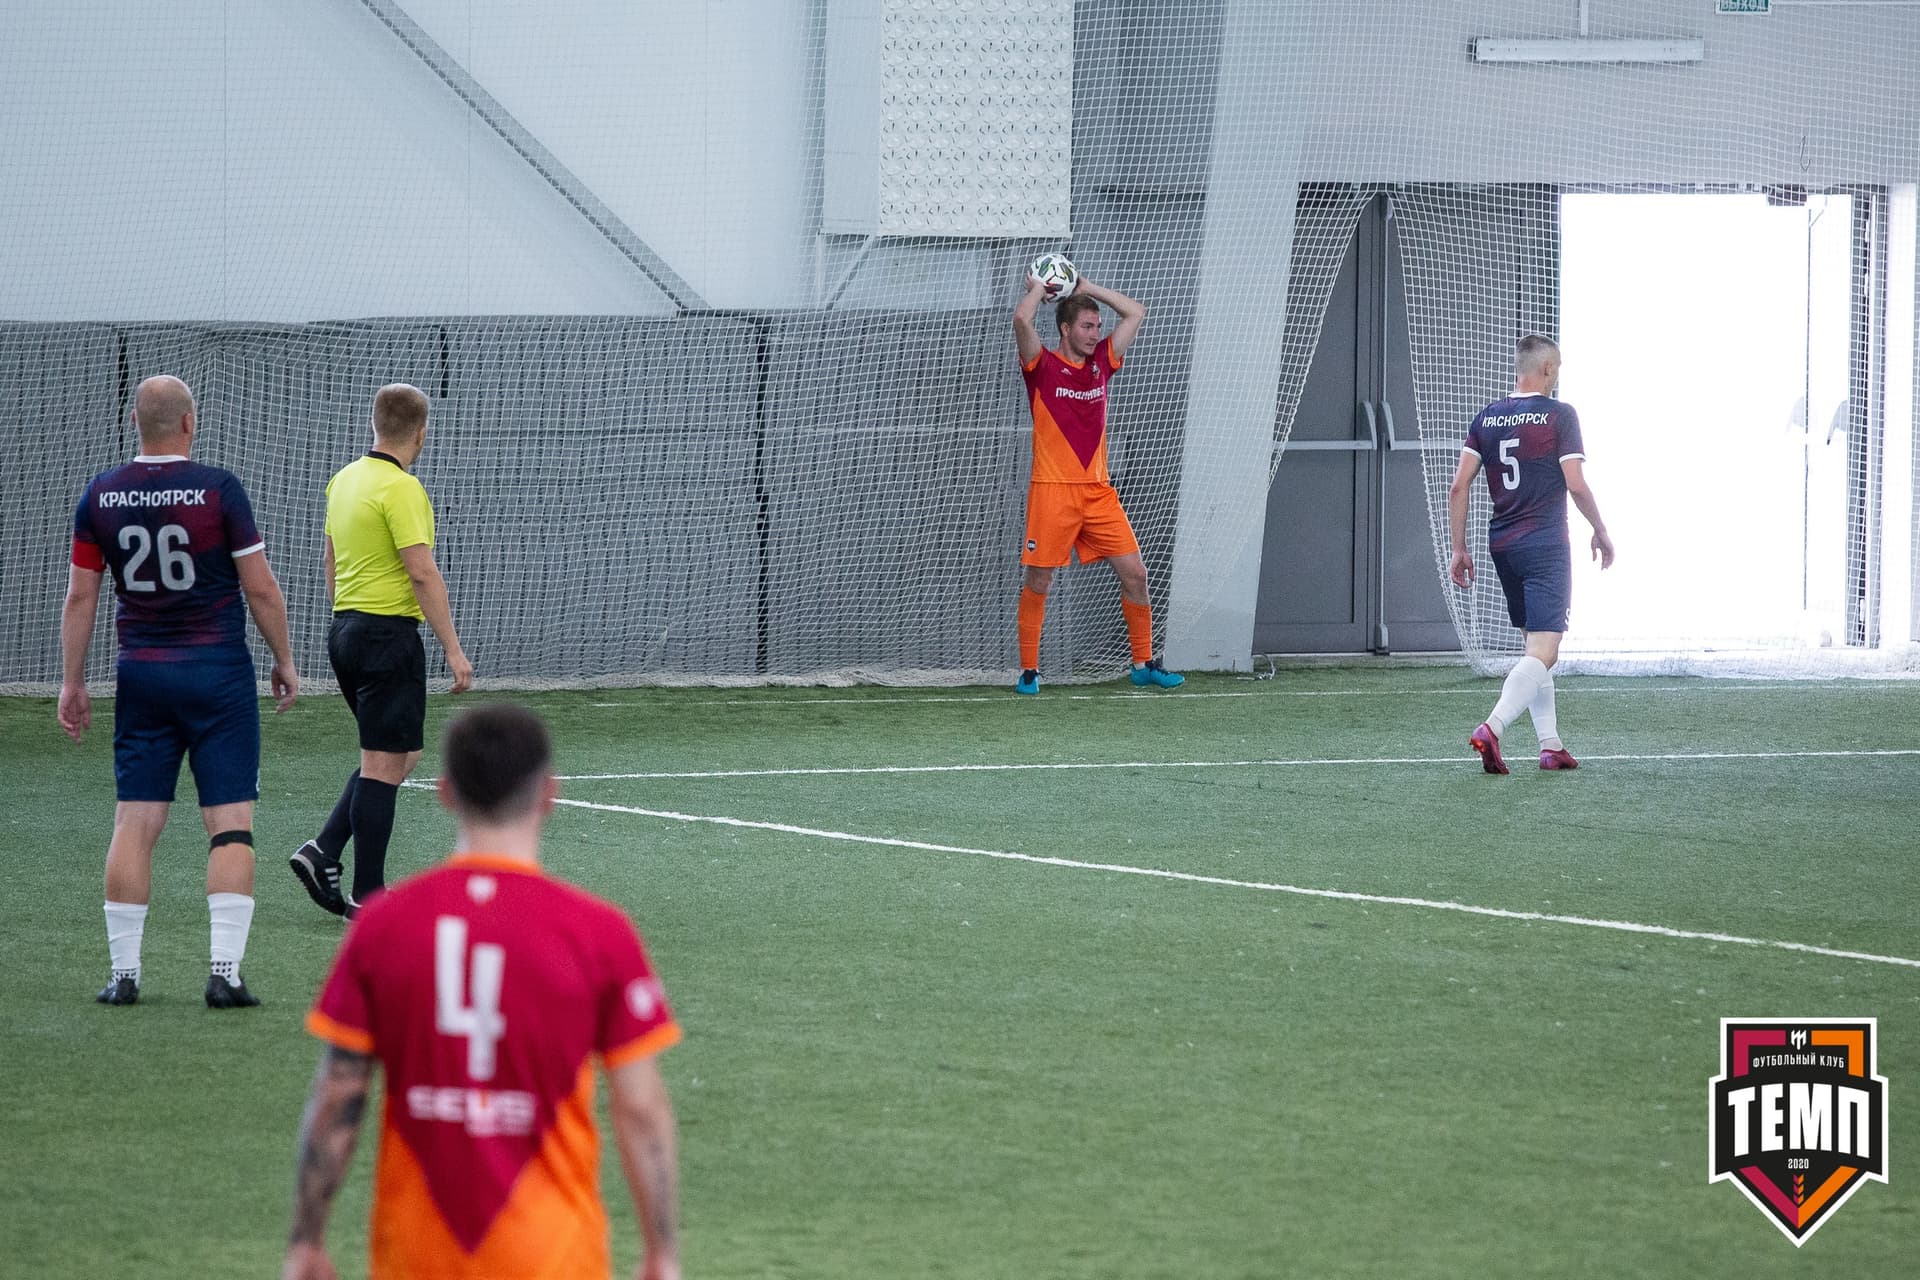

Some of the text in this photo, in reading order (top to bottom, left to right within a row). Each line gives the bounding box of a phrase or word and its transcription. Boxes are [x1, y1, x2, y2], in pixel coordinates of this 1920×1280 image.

[1482, 412, 1549, 428] КРАСНОЯРСК
[1499, 438, 1520, 490] 5
[99, 489, 206, 508] КРАСНОЯРСК
[118, 524, 196, 592] 26
[436, 915, 505, 1081] 4
